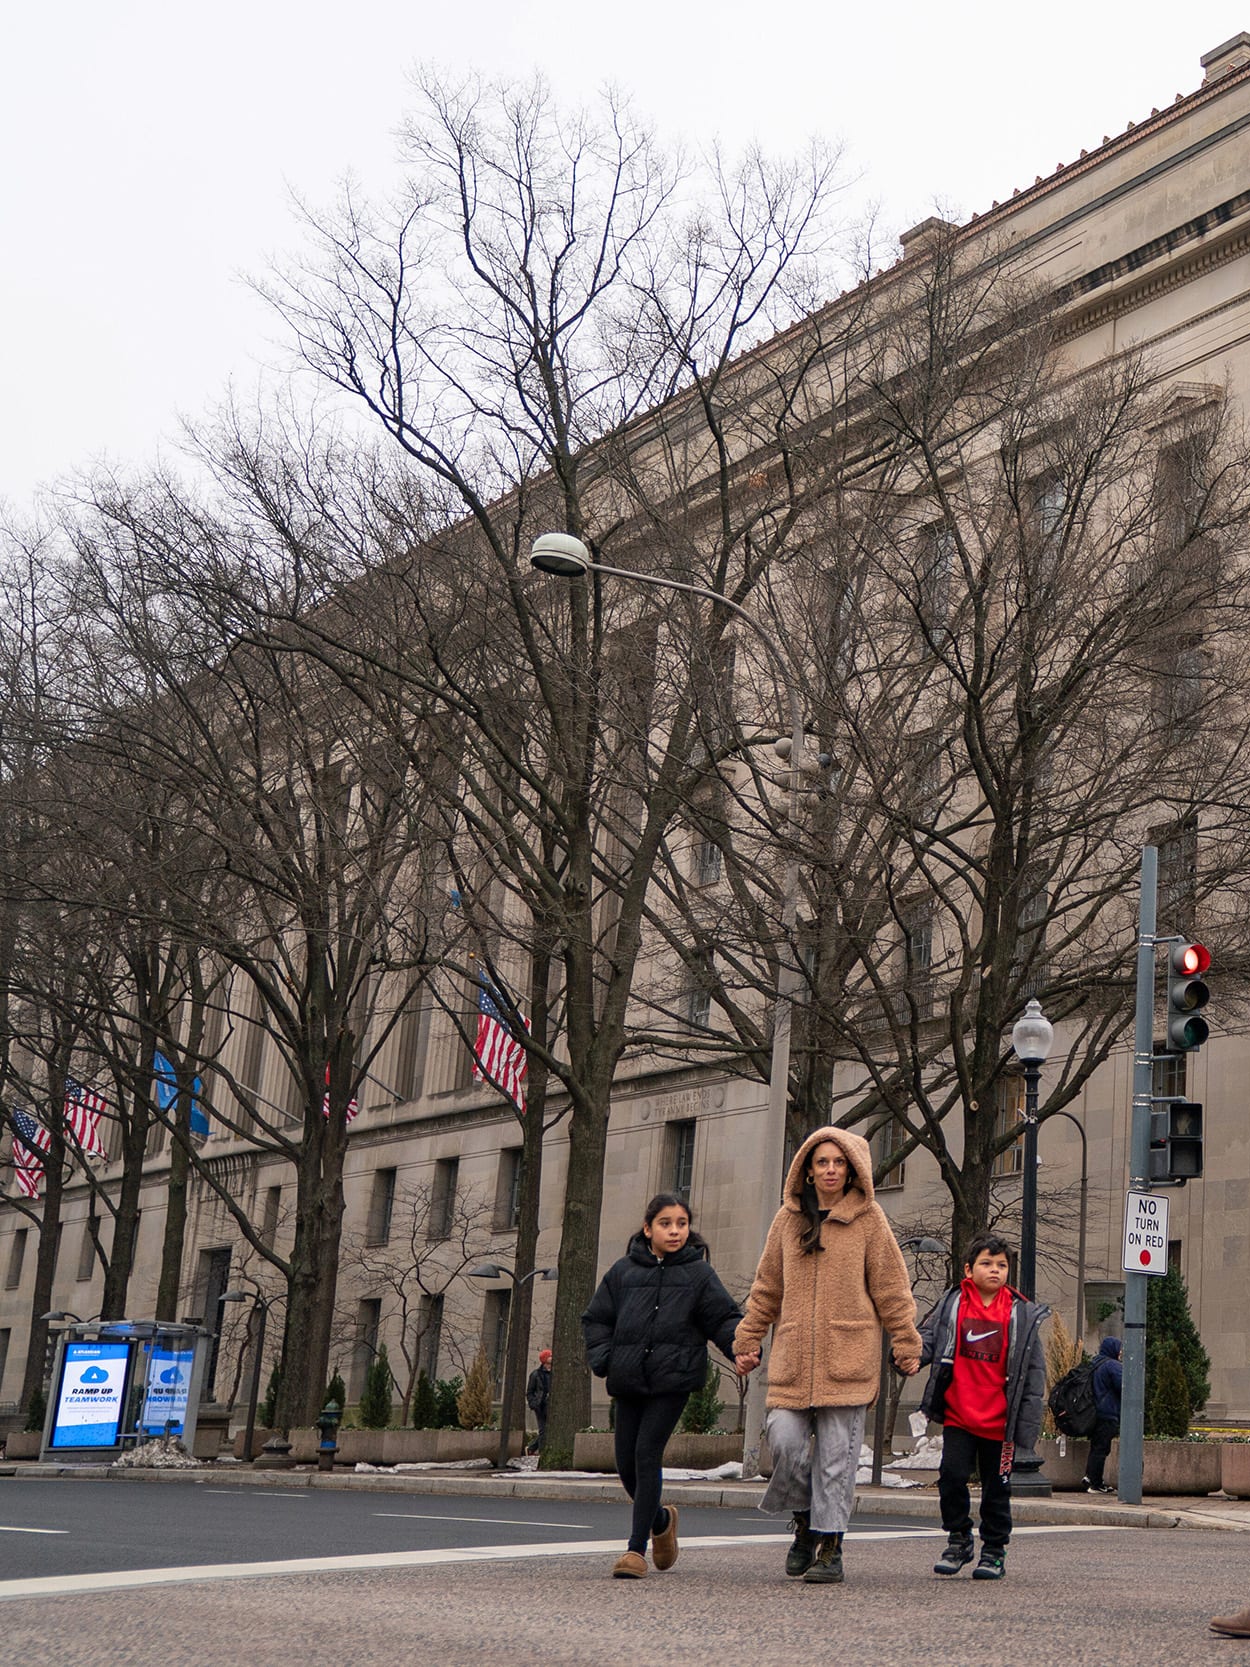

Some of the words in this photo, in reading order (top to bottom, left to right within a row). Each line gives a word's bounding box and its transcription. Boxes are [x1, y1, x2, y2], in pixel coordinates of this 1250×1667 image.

[1138, 1199, 1157, 1215] NO
[1135, 1217, 1159, 1231] TURN
[1128, 1233, 1141, 1245] ON
[1145, 1235, 1164, 1248] RED
